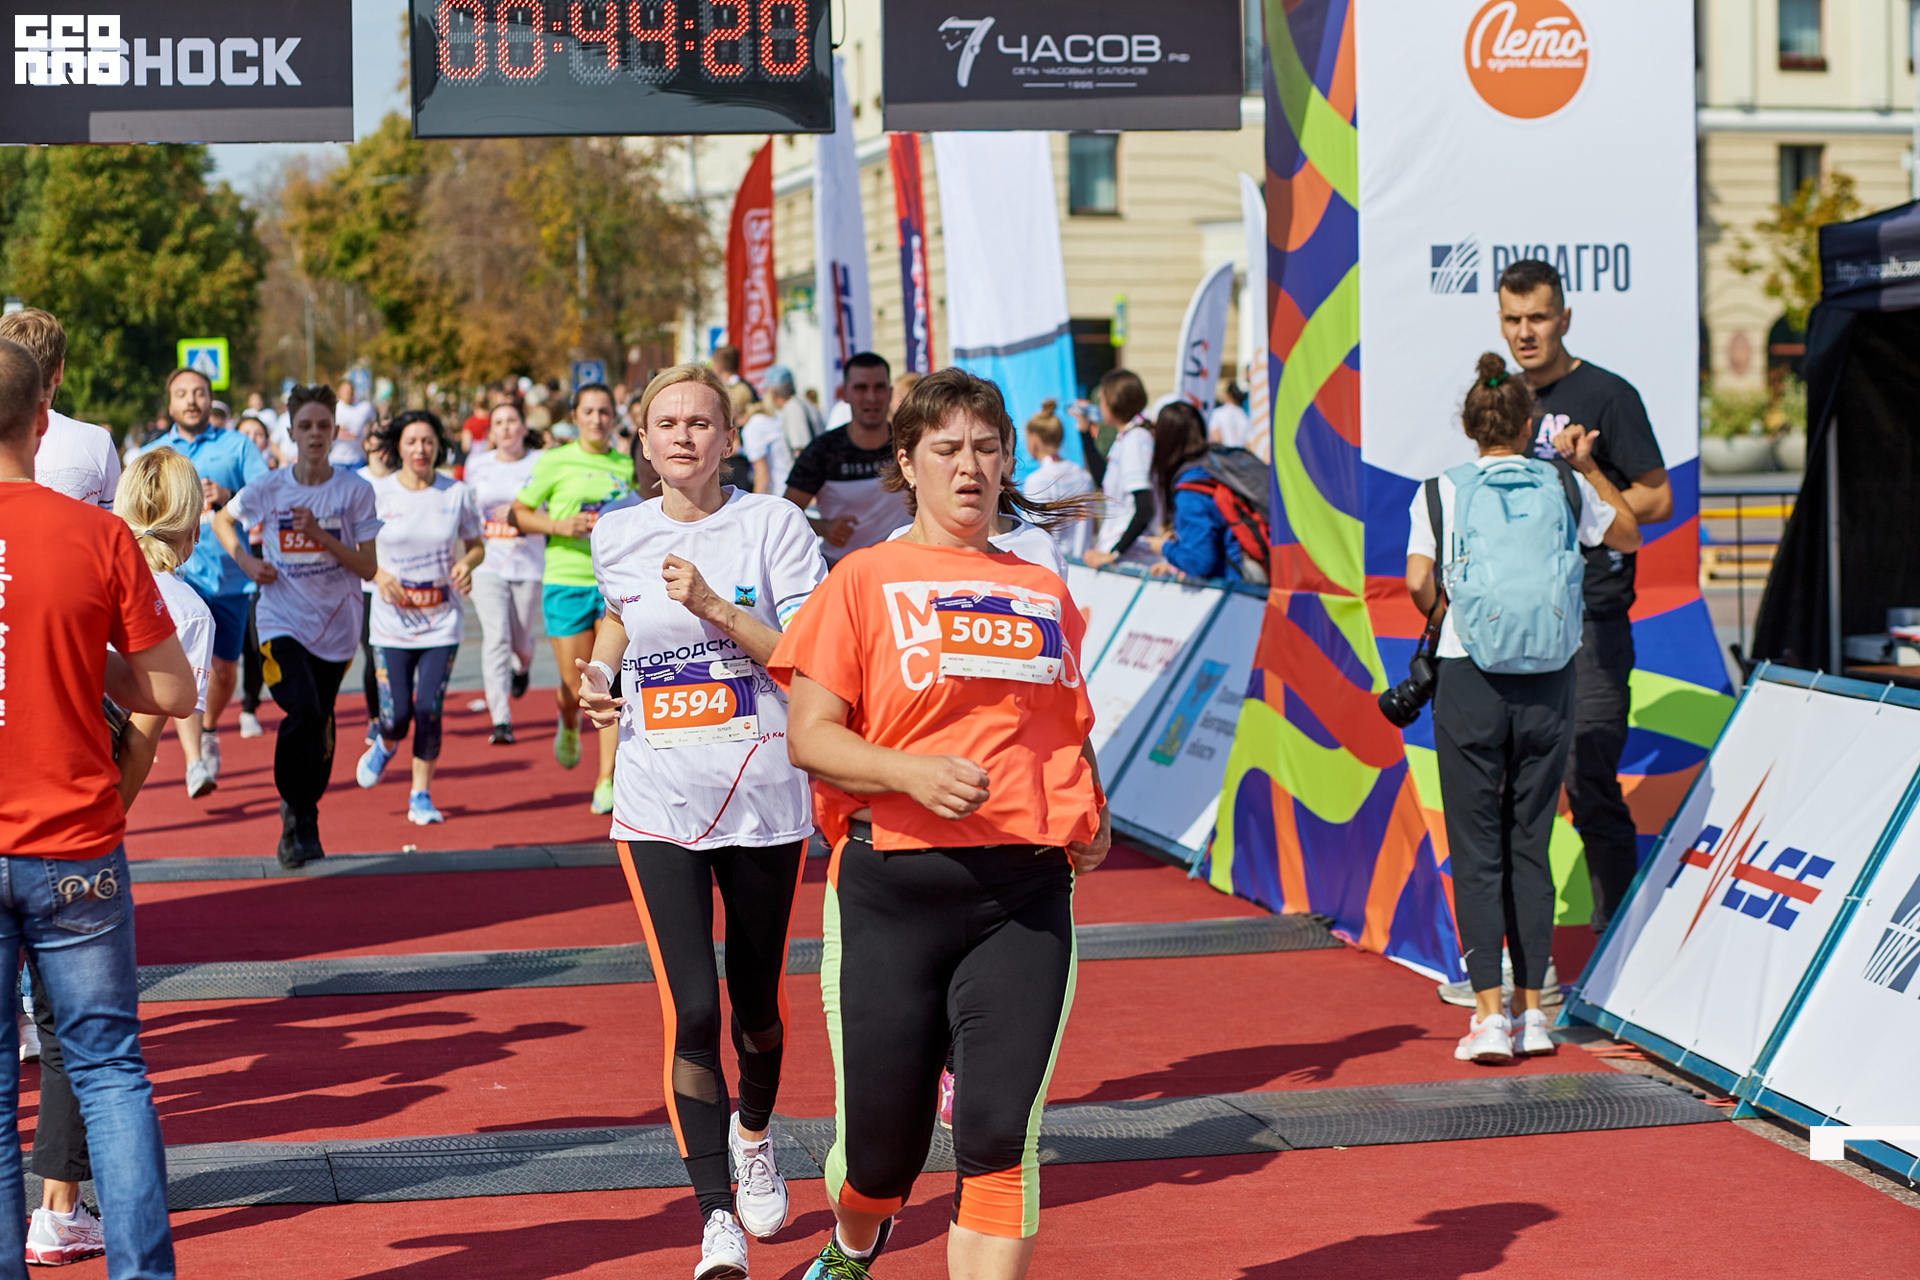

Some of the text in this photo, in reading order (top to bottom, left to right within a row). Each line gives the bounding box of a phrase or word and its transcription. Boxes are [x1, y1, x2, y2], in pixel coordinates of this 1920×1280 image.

[437, 0, 810, 80] 00:44:20
[938, 16, 996, 88] 7
[1492, 243, 1630, 293] РАГРО
[951, 615, 1034, 649] 5035
[651, 687, 728, 720] 5594
